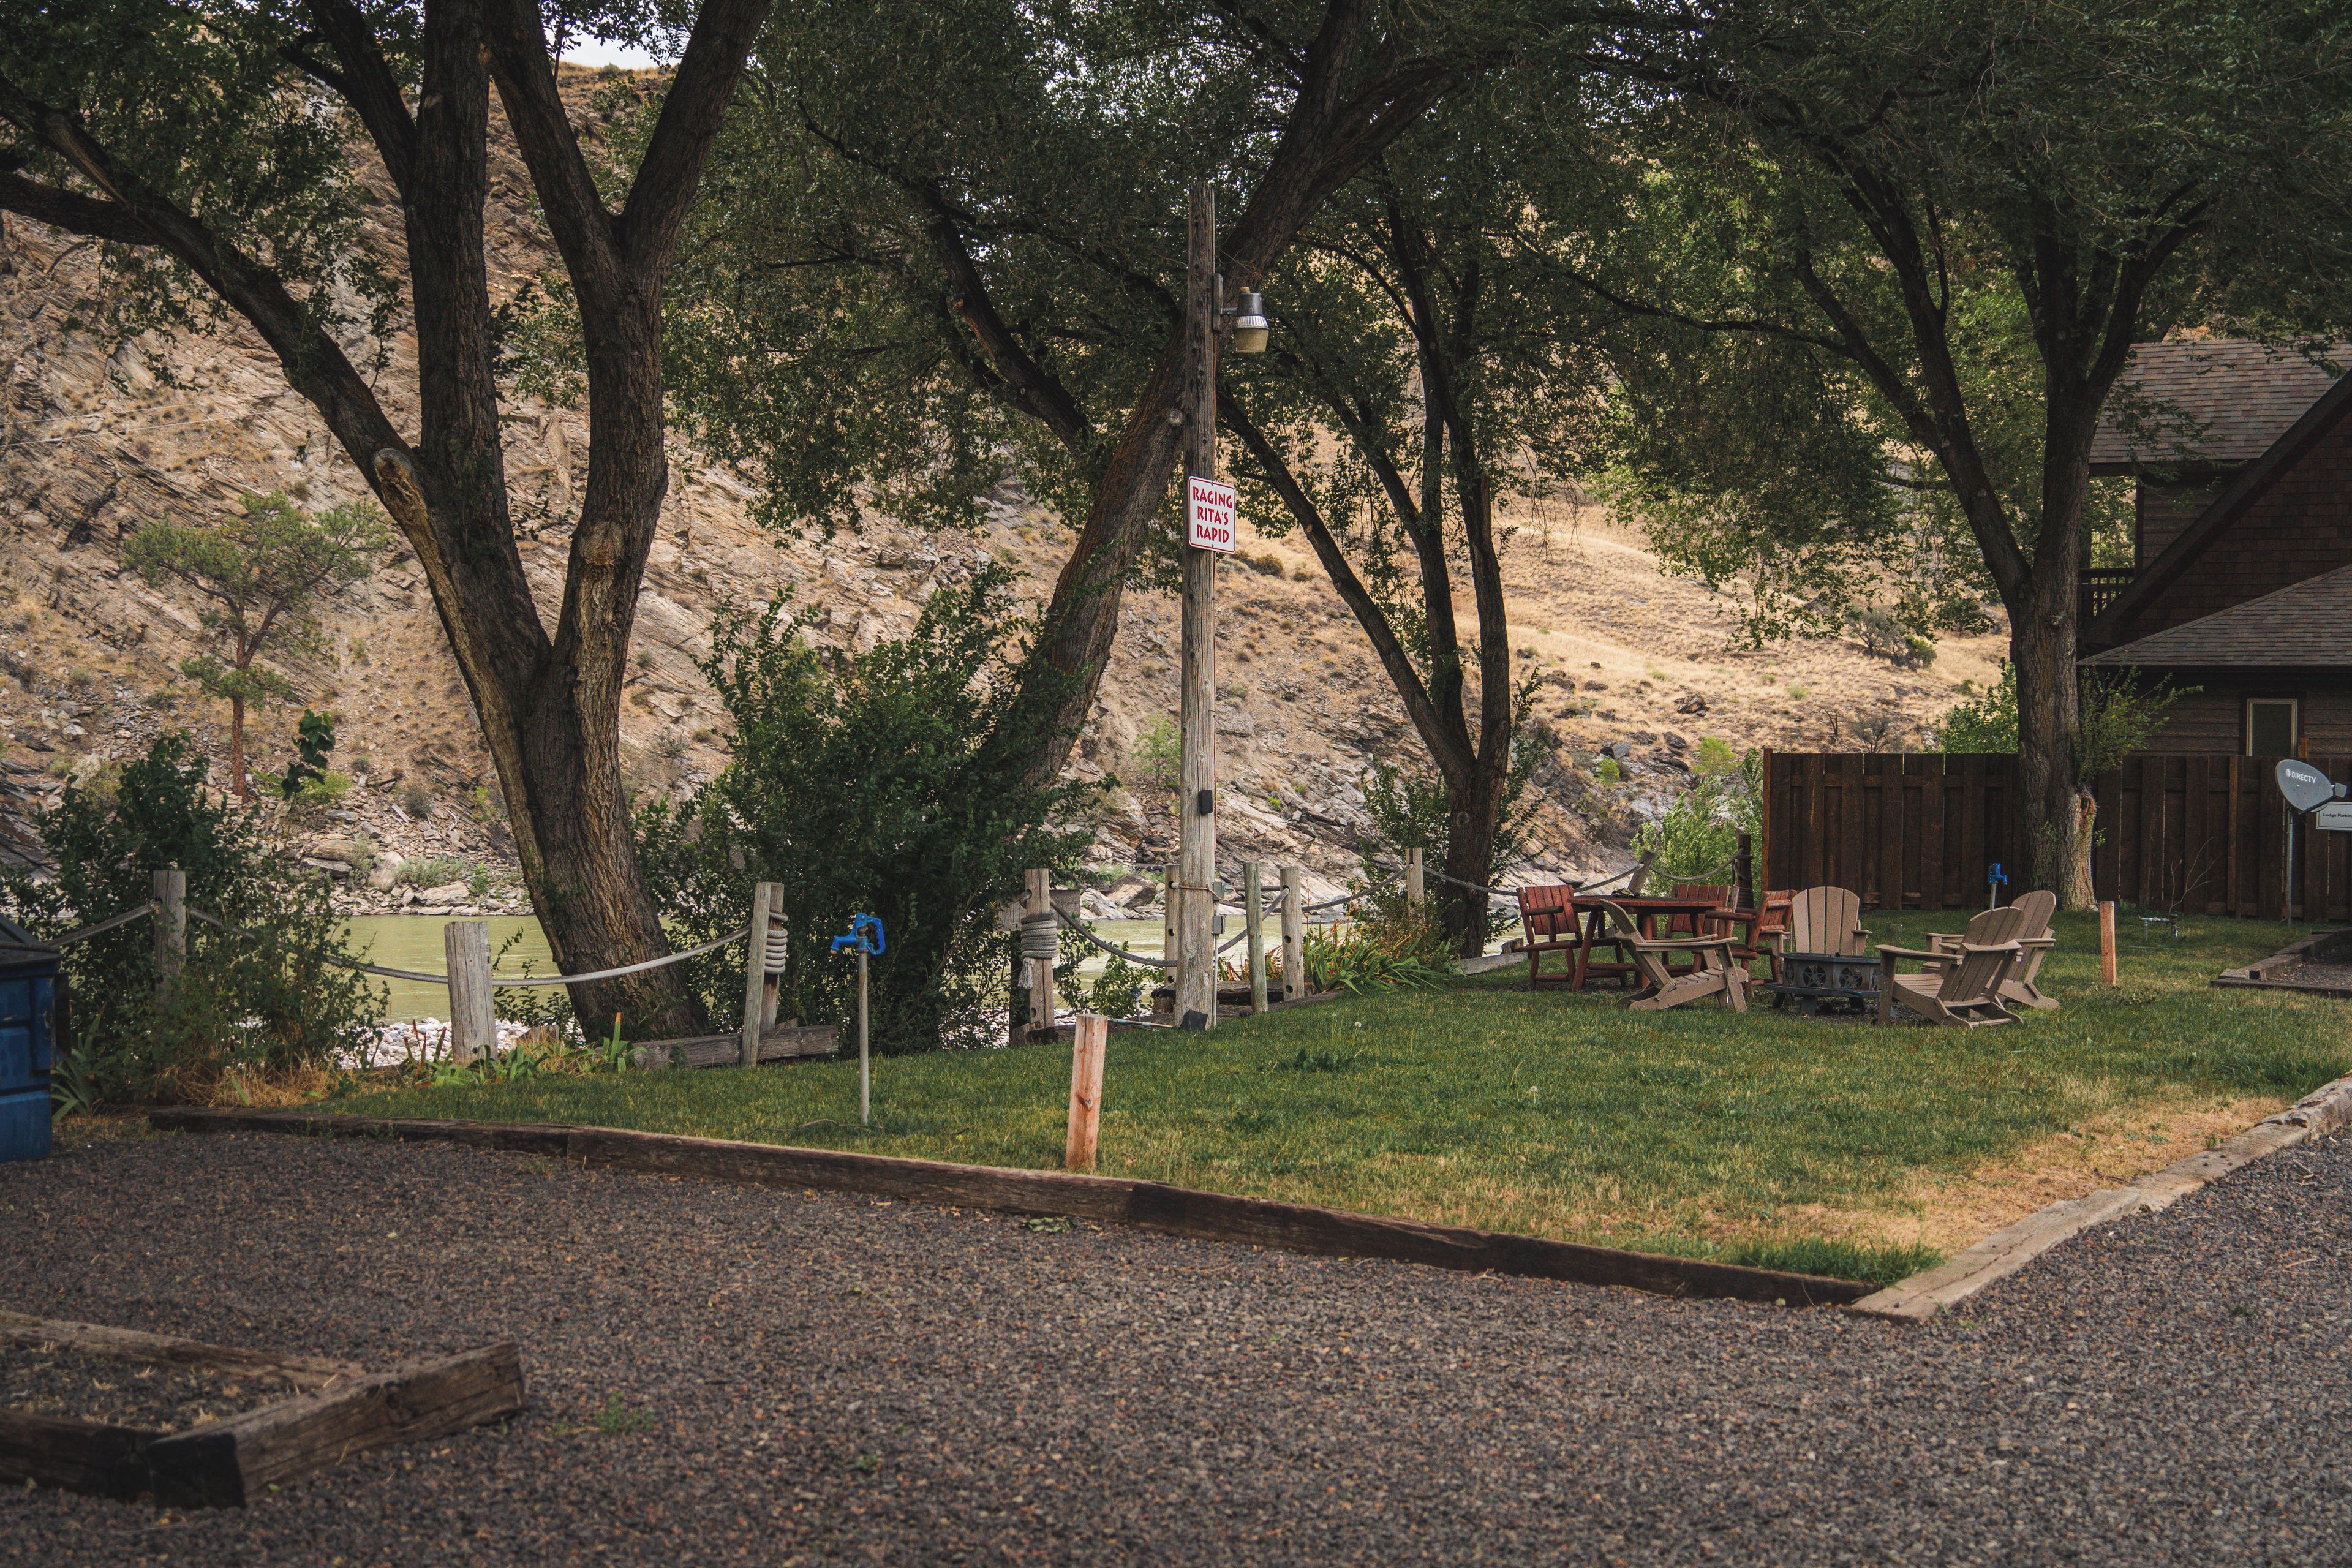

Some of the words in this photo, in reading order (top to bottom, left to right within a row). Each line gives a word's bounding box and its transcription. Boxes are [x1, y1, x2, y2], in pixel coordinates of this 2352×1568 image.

[1193, 486, 1232, 508] RAGING
[1197, 505, 1229, 526] RITA'S
[1197, 524, 1229, 543] RAPID
[2291, 771, 2316, 783] DIRECTV
